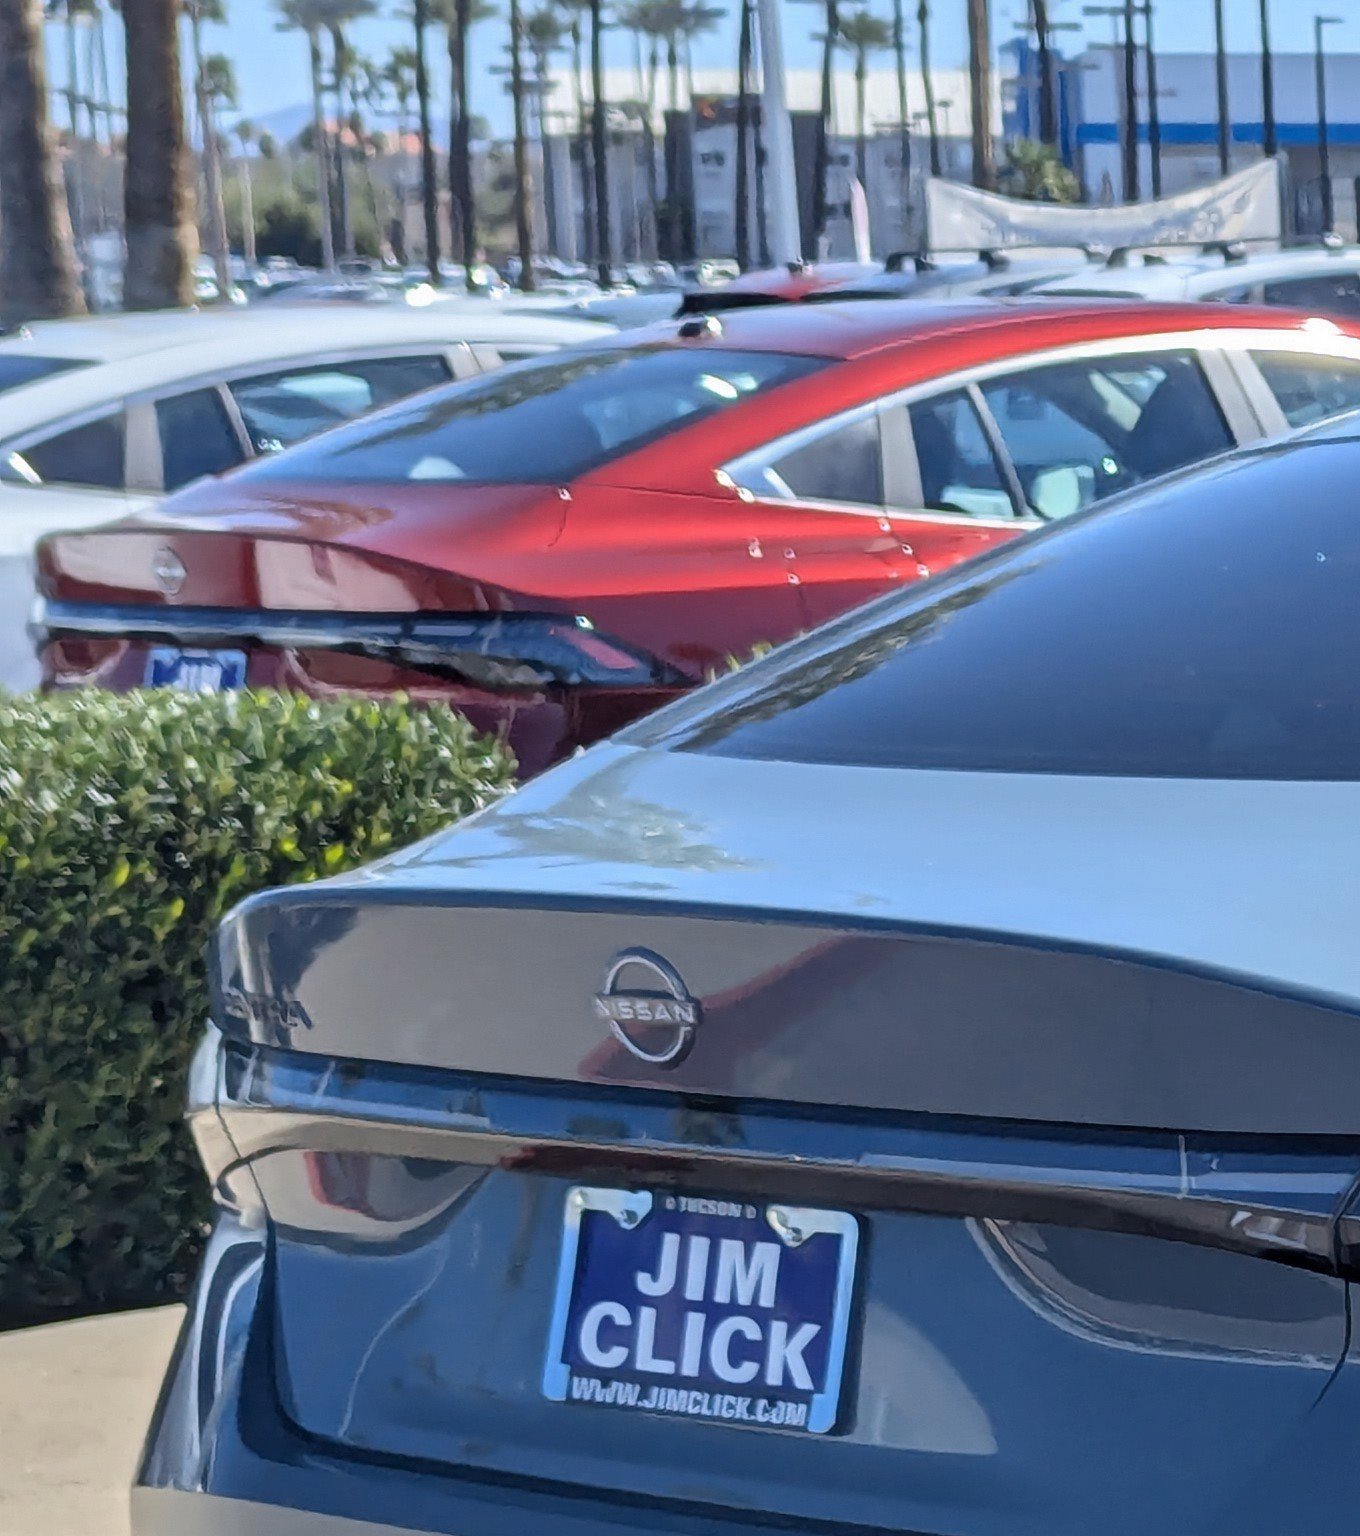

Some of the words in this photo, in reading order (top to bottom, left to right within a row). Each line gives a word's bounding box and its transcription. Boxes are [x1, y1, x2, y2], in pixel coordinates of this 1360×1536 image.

[595, 997, 696, 1023] NISSAN
[635, 1232, 781, 1308] JIM
[580, 1301, 821, 1390] CLICK
